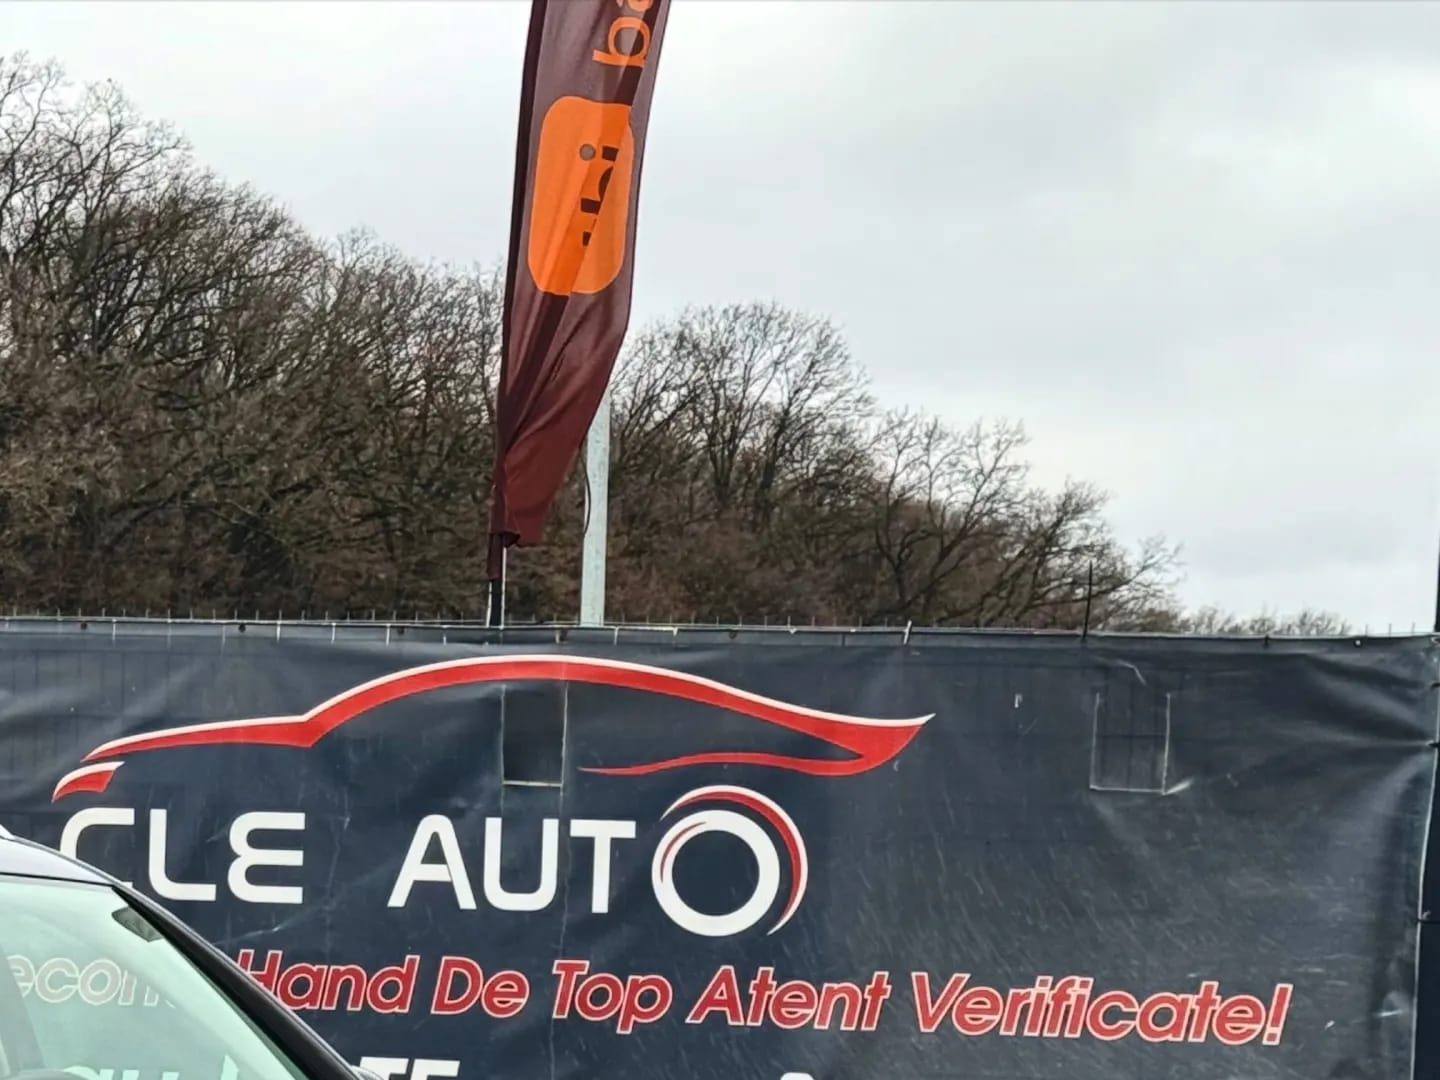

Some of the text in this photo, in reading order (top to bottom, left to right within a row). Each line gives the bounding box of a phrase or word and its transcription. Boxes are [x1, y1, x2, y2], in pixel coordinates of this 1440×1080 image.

[61, 807, 780, 936] CLE AUTO
[235, 949, 418, 1014] Hand
[431, 956, 530, 1016] De
[550, 960, 673, 1034] Top
[685, 966, 891, 1031] Atent
[911, 972, 1293, 1046] Verificate!
